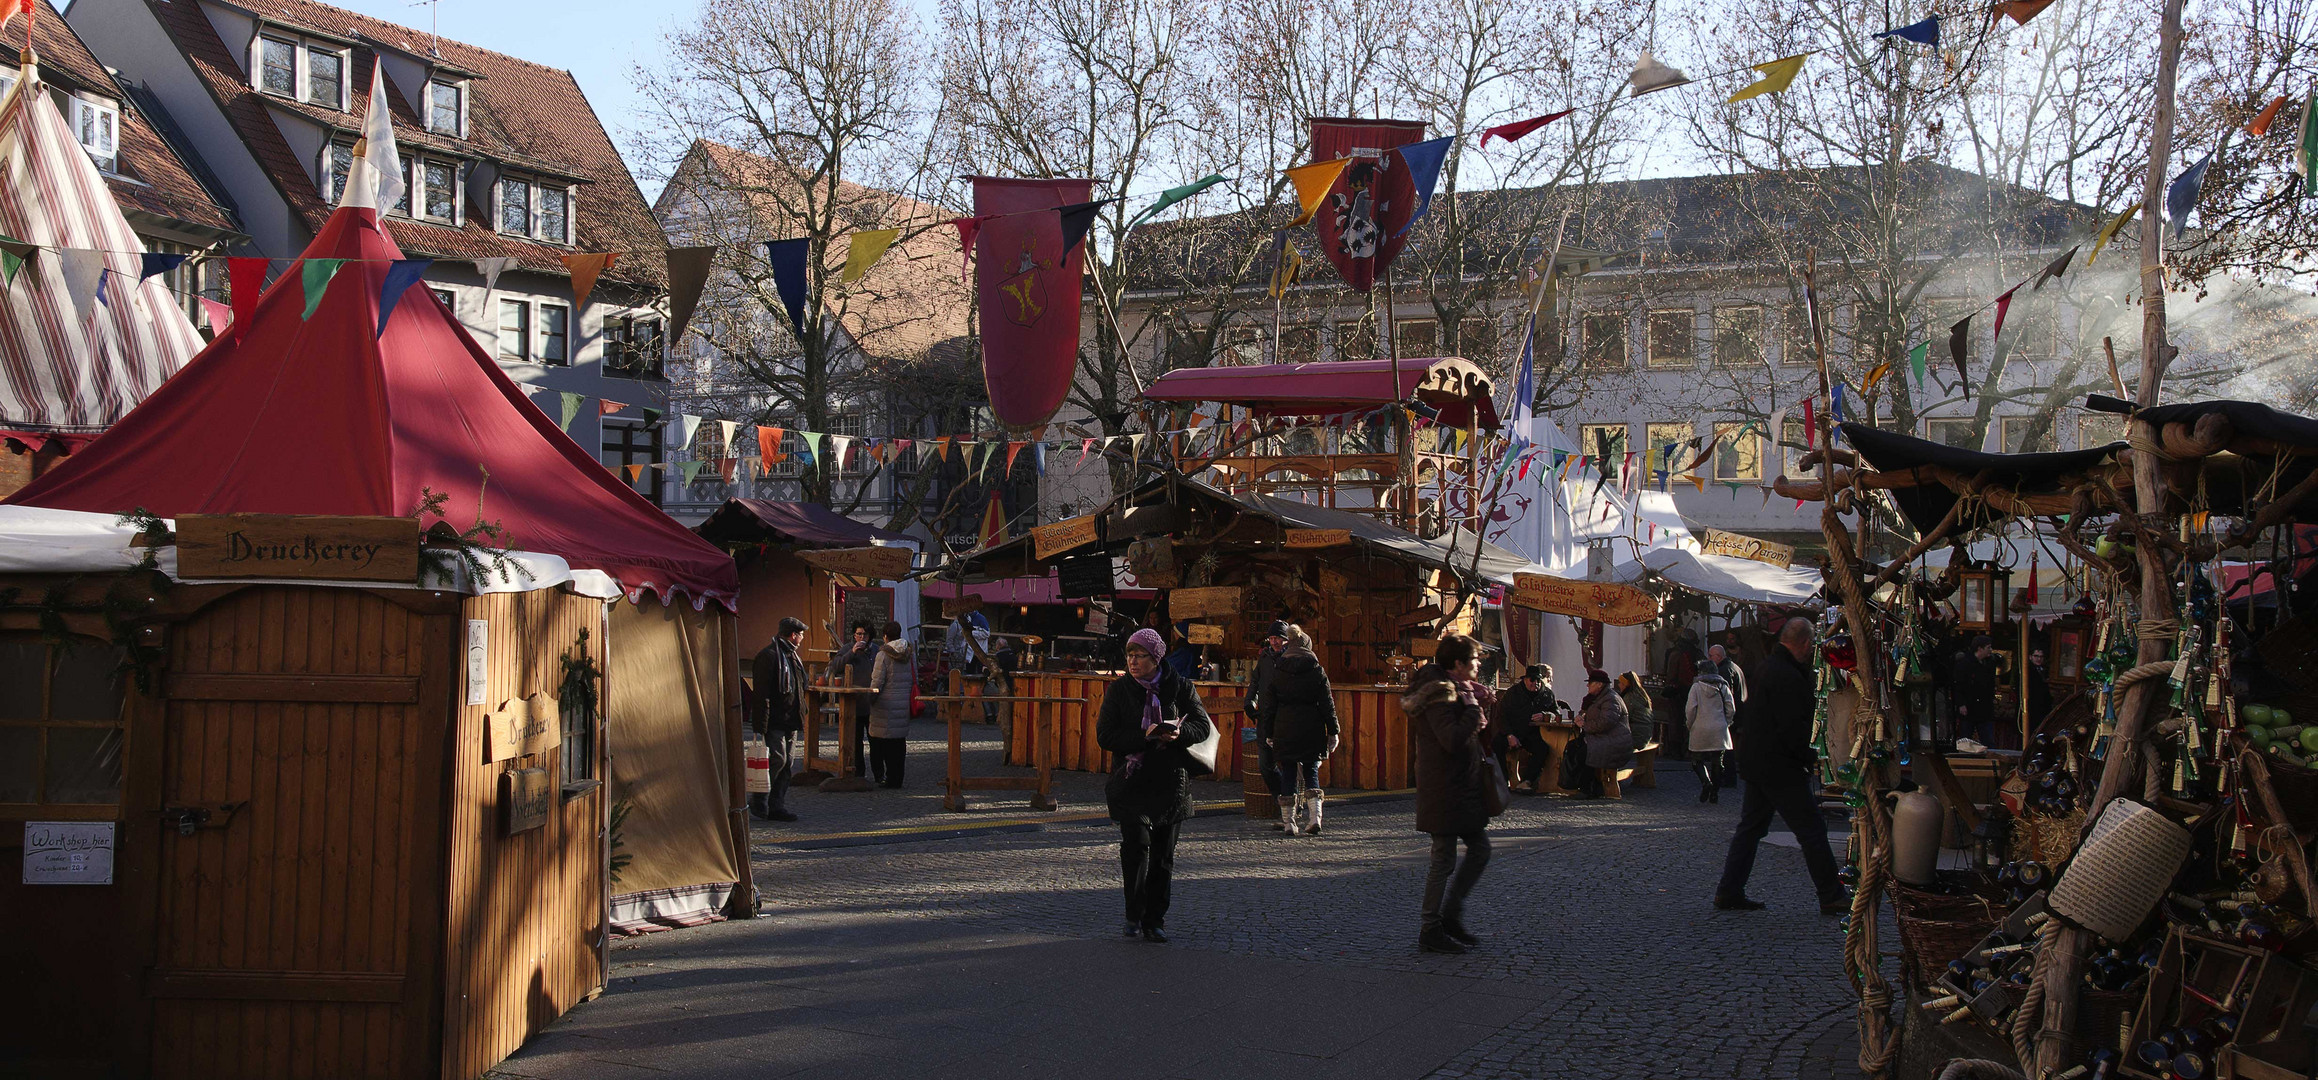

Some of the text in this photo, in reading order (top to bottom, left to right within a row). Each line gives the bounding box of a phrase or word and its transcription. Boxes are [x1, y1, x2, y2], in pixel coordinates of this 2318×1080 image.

[219, 529, 383, 571] Druckerey
[1289, 532, 1337, 544] Glühwein
[1703, 531, 1788, 562] Heisse Maroni
[1517, 577, 1576, 597] Glühweine
[1629, 589, 1650, 610] Met
[1510, 596, 1522, 651] AFFEE
[508, 714, 552, 745] Druckerey
[31, 829, 110, 852] Workshop hier
